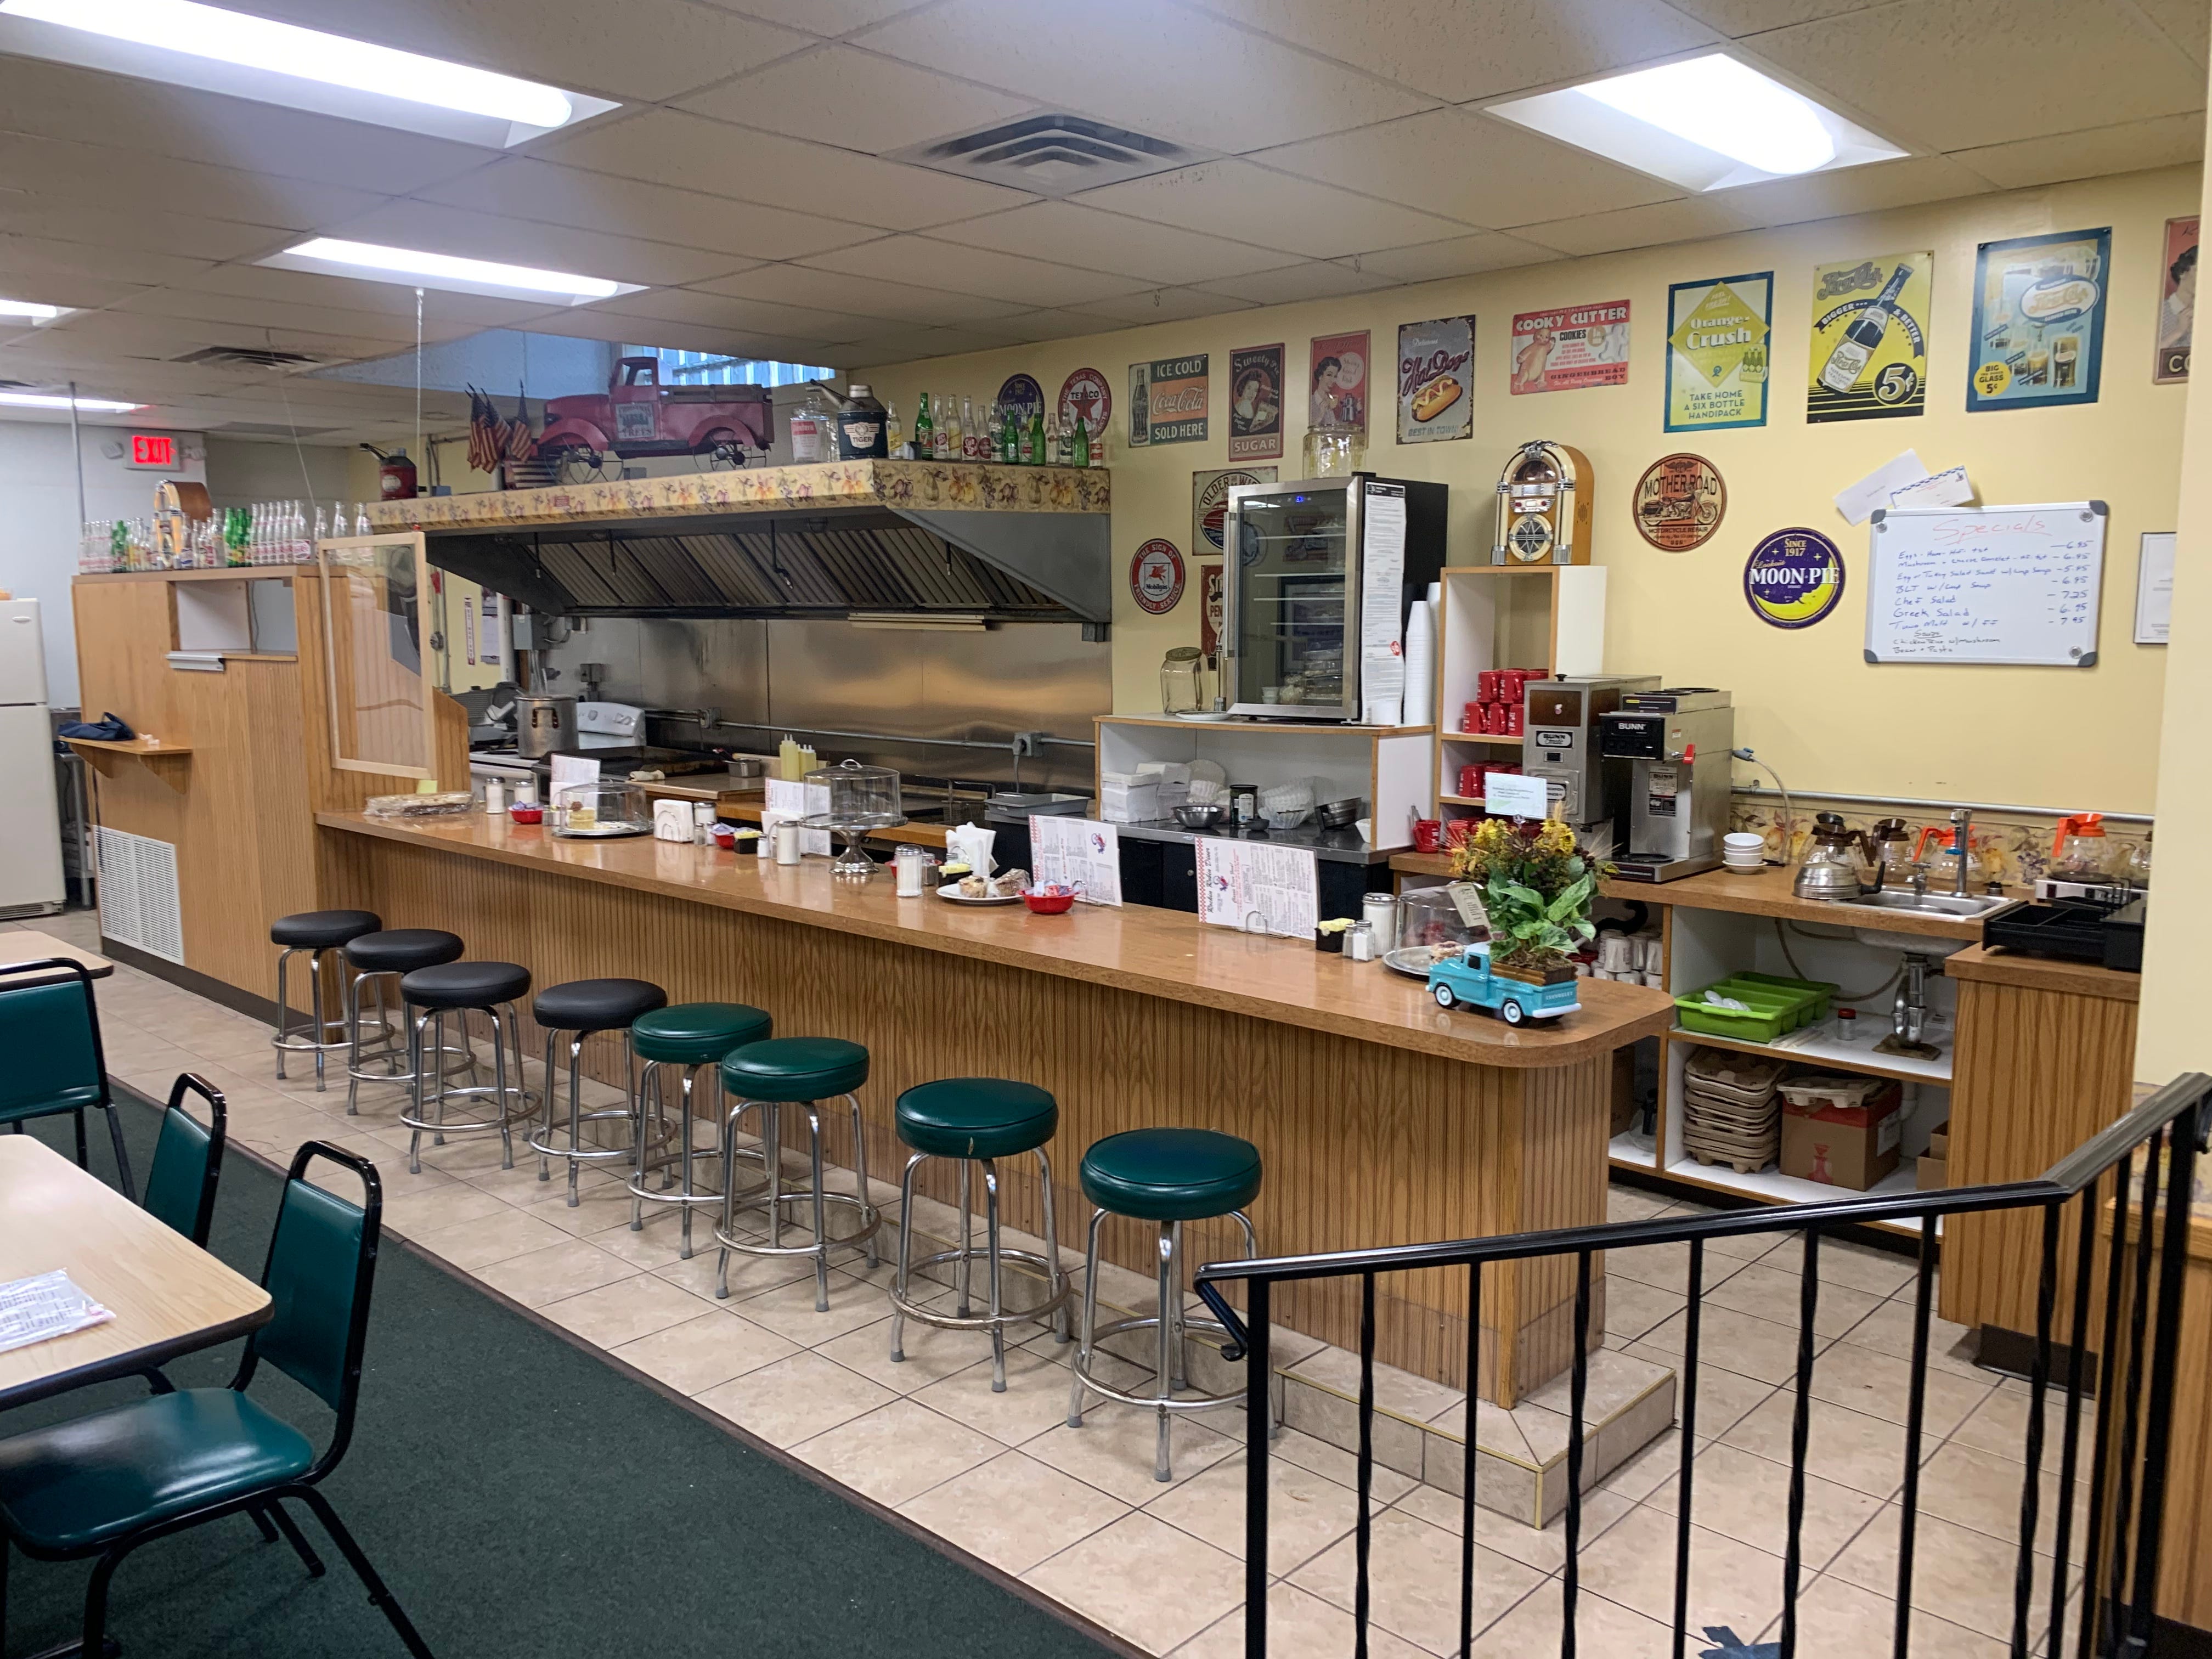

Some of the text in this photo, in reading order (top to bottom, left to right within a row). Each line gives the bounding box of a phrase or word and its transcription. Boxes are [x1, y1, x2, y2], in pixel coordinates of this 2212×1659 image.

[1516, 315, 1565, 332] COOKY
[1570, 307, 1627, 325] CUTTER
[1560, 329, 1587, 341] COOKIES
[1900, 313, 1921, 344] BETTER
[1686, 327, 1751, 350] Crush
[1157, 360, 1201, 378] ICE COLD
[1550, 367, 1626, 380] GINGERBREAD
[1878, 365, 1915, 401] 5¢
[1153, 386, 1206, 416] Coca-Cola
[1690, 390, 1743, 402] TAKE HOME
[1692, 401, 1706, 410] SIX
[1709, 399, 1745, 409] BOTTLE
[999, 402, 1042, 416] MOON PIE
[1689, 409, 1741, 420] HANDIPACK
[1155, 422, 1203, 440] SOLD HERE
[1408, 427, 1425, 437] BEST
[1427, 426, 1435, 436] IN
[132, 435, 172, 465] EXIT
[1234, 439, 1276, 453] SUGAR
[1203, 476, 1229, 506] OLDER
[1644, 473, 1717, 499] MOTHER ROAD
[1933, 515, 2045, 545] Specials
[1138, 544, 1176, 560] THE SIGN OF
[1785, 548, 1807, 557] 1917
[1749, 567, 1840, 585] MOON PIE
[1133, 583, 1181, 609] FRIENDLY SERVICE
[1896, 585, 1919, 594] BLT
[1930, 595, 1957, 604] Salad
[1893, 608, 1929, 618] Greek
[1937, 608, 1970, 617] Salad
